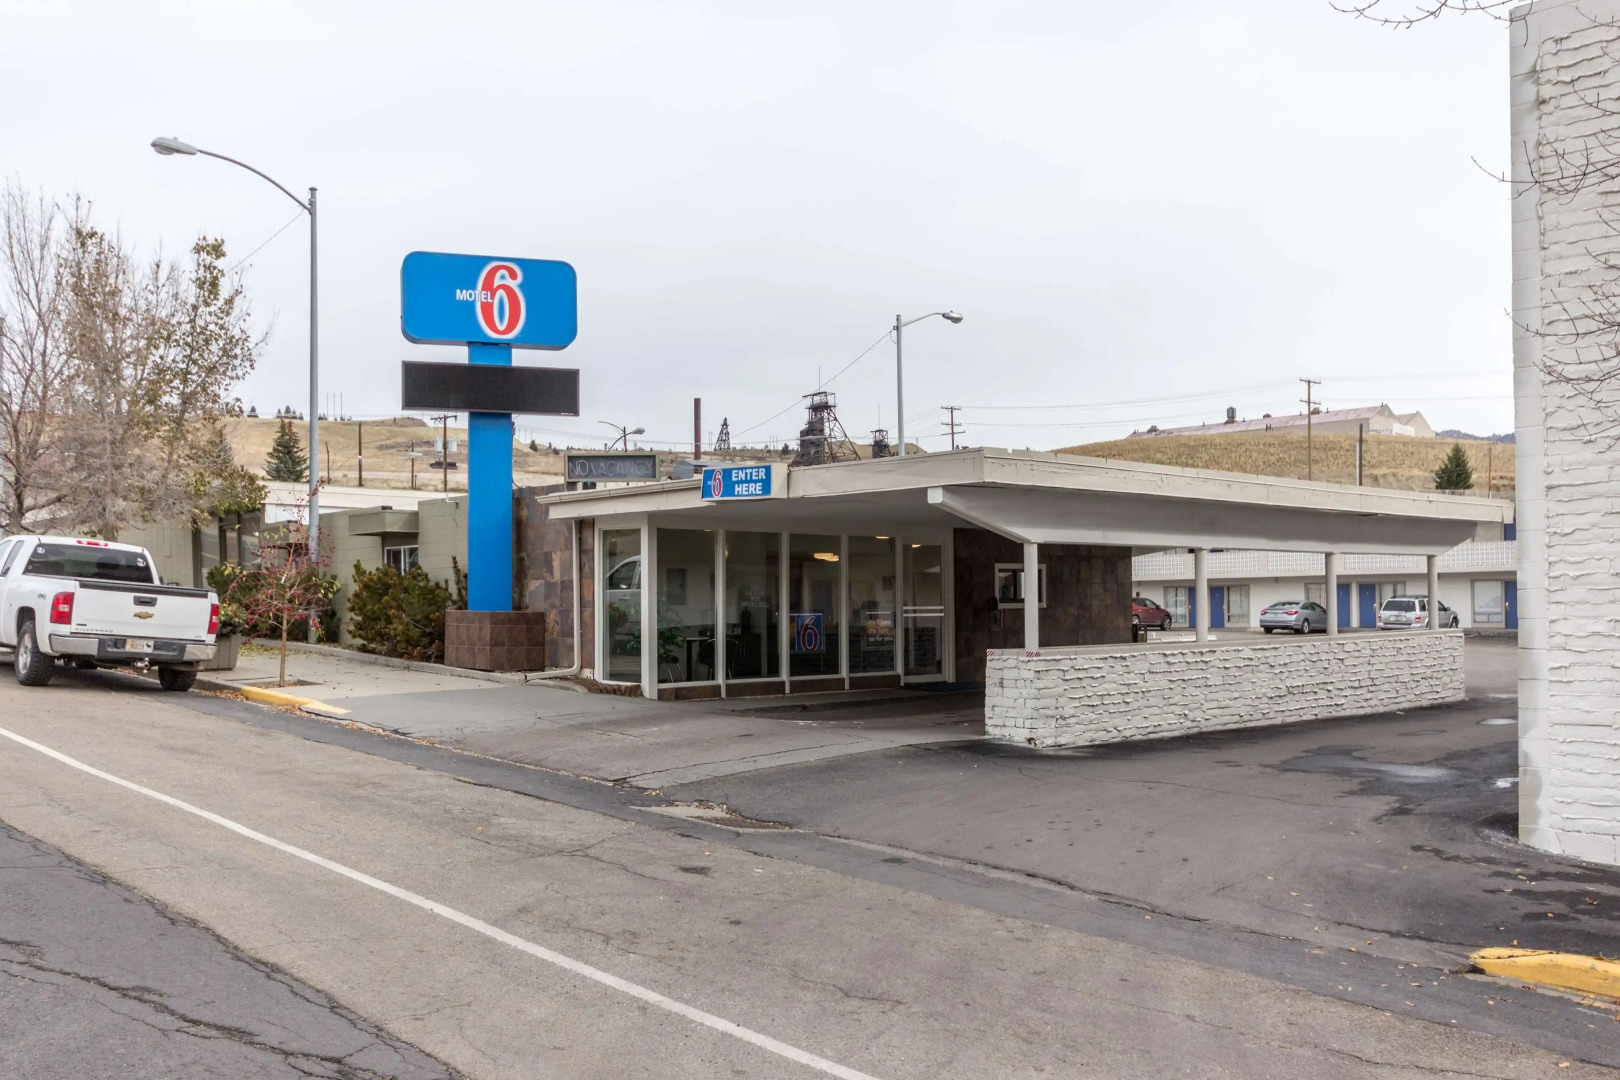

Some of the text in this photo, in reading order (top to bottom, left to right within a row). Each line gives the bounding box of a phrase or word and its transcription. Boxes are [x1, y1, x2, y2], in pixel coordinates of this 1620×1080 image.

[456, 262, 525, 338] MOTEL 6
[568, 459, 654, 477] NO VACANCY
[731, 467, 766, 481] ENTER
[711, 469, 723, 498] 6
[734, 482, 763, 496] HERE
[800, 615, 819, 651] 6
